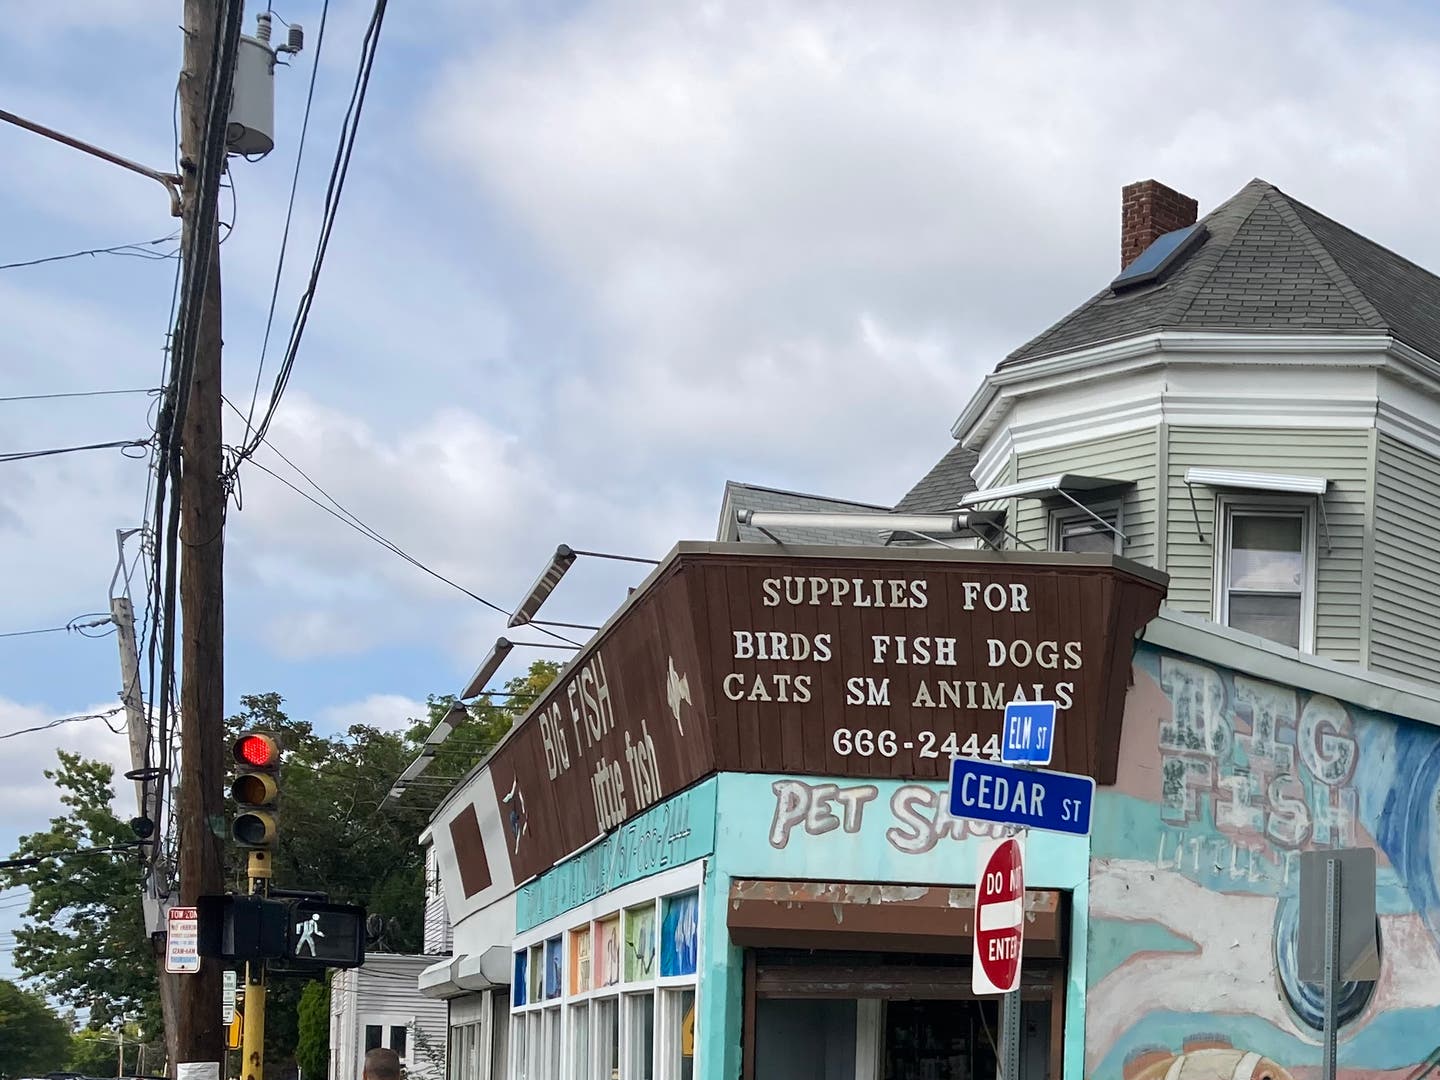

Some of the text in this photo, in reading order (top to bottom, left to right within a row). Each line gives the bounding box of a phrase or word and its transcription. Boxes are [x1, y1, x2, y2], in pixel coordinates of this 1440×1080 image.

[763, 577, 1030, 612] SUPPLIES FOR
[733, 631, 1082, 669] BIRDS FISH DOGS
[723, 673, 1074, 710] CATS SM ANIMALS
[538, 651, 615, 781] BIG FISH
[1009, 716, 1048, 750] ELM ST
[1159, 656, 1359, 786] BIG
[832, 728, 1001, 760] 666-2444
[590, 719, 663, 834] little fish
[961, 772, 1082, 823] CEDAR ST
[769, 780, 1014, 854] PET SH
[1160, 754, 1359, 850] FISH
[986, 871, 1003, 895] DO
